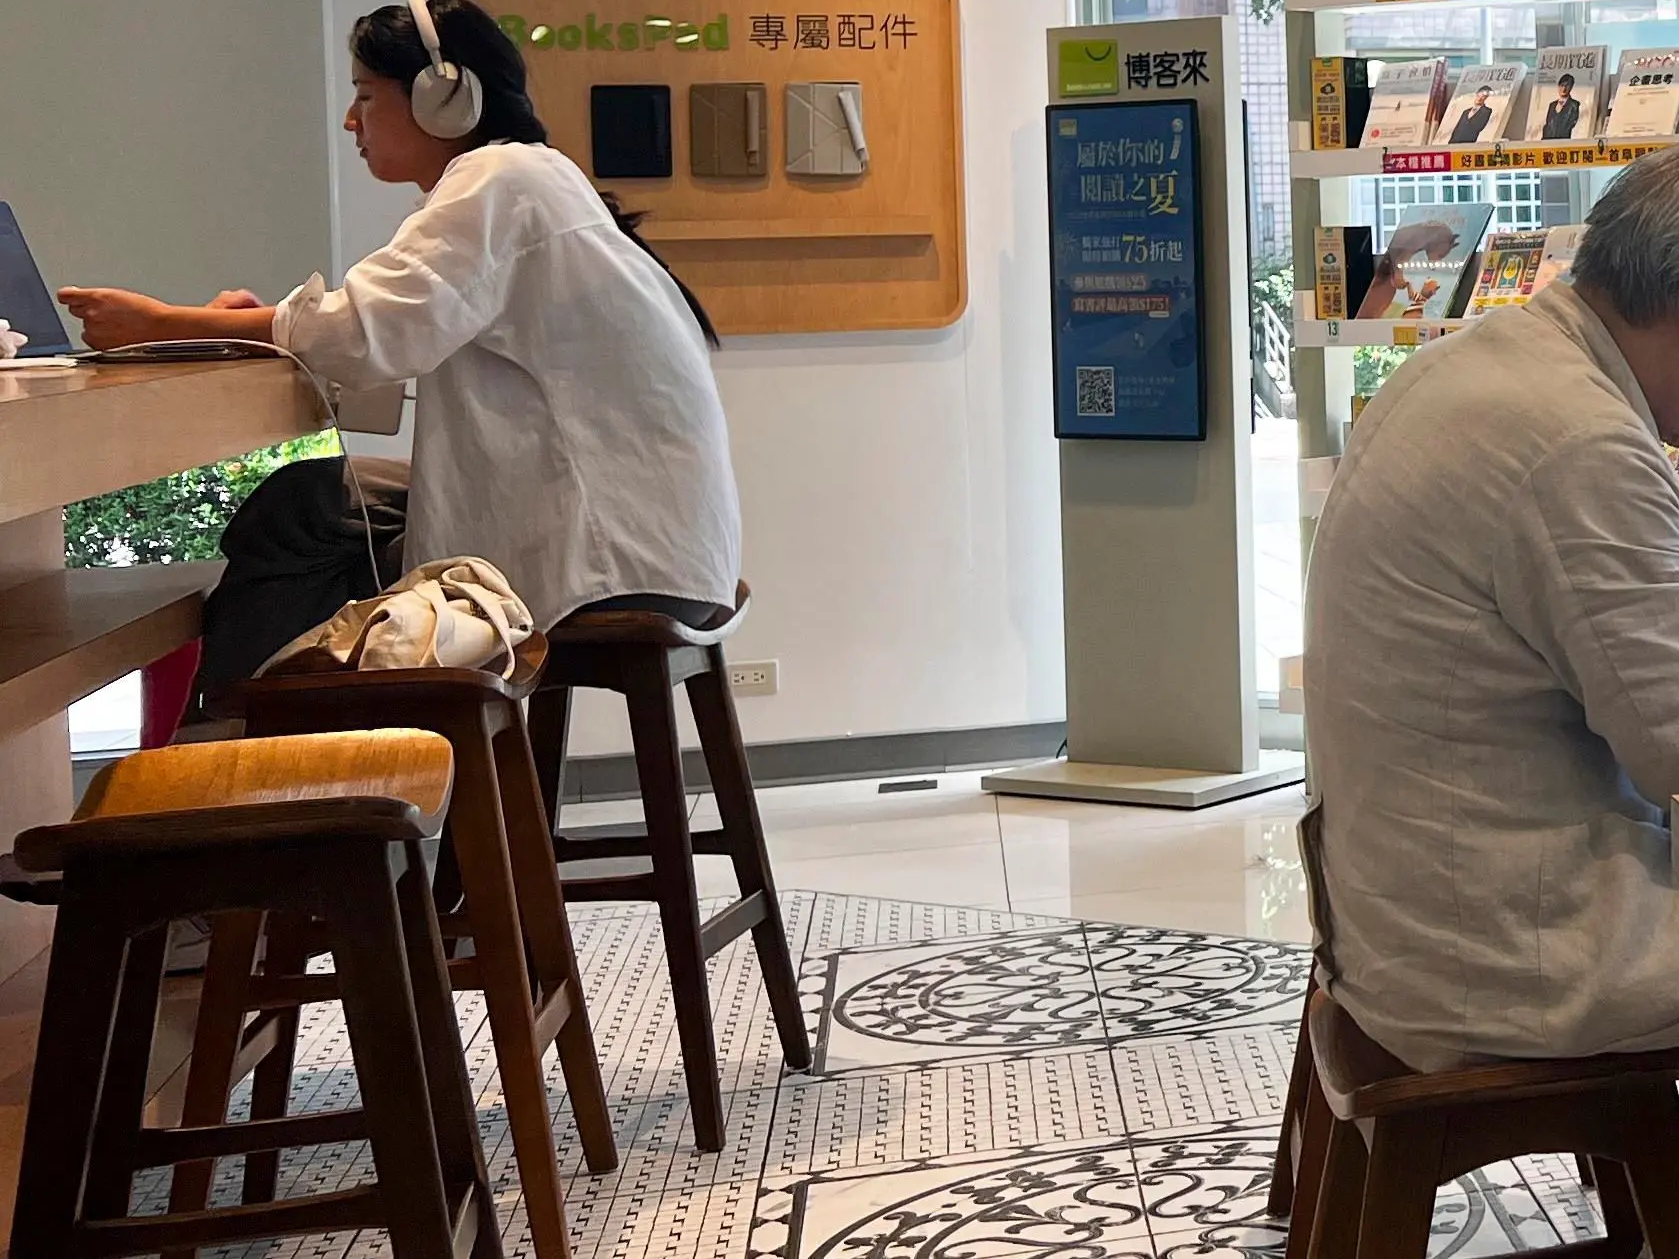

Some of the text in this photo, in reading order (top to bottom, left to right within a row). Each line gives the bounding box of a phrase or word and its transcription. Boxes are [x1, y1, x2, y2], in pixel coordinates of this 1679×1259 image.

[749, 12, 919, 52] 專屬配件
[1124, 49, 1210, 90] 博客來
[1077, 137, 1164, 168] 屬於你的
[1080, 170, 1180, 216] 閱讀之夏
[1328, 322, 1339, 337] 13
